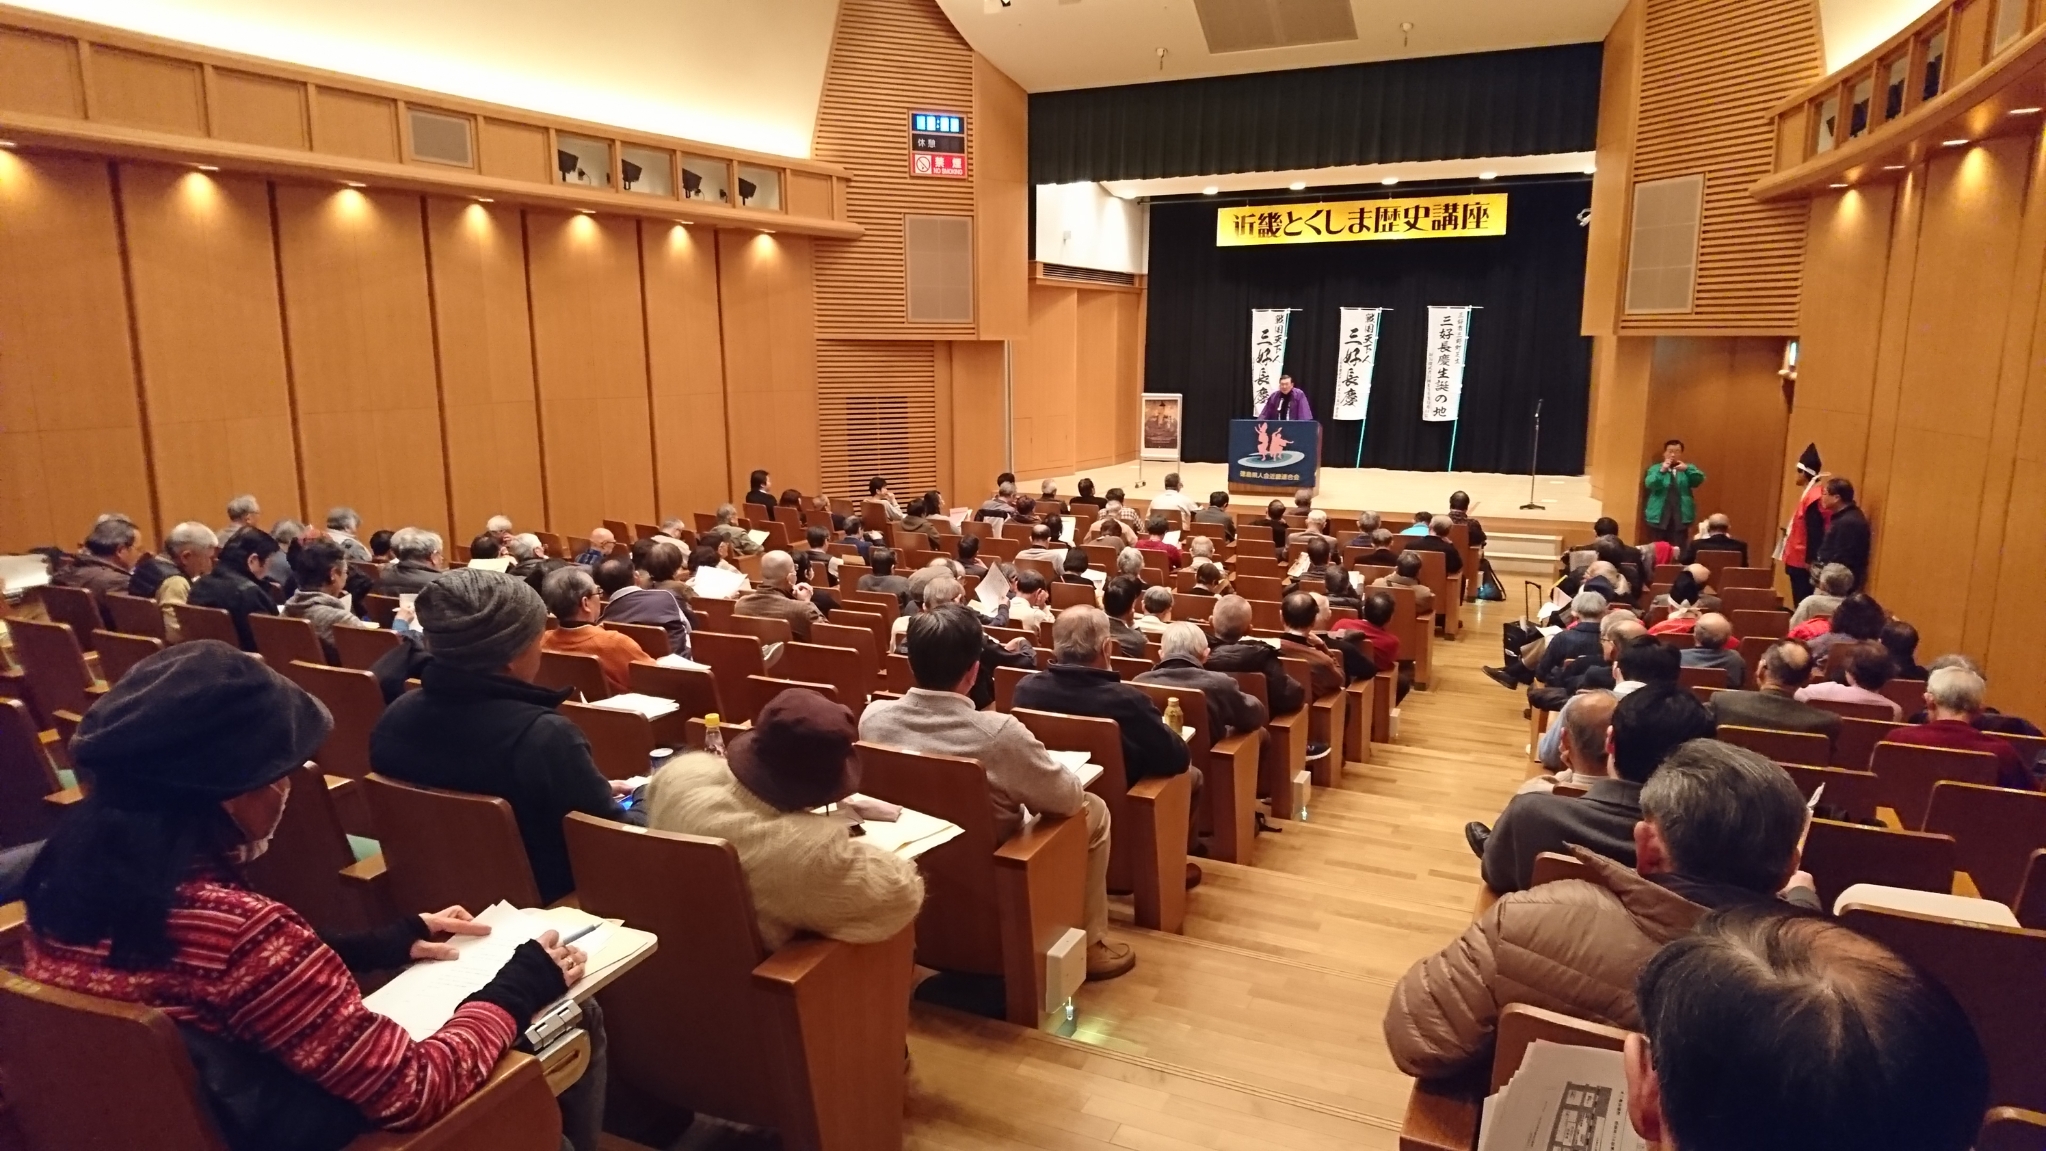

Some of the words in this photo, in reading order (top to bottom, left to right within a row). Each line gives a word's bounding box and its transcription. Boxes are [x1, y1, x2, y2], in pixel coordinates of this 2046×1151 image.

[1233, 202, 1490, 238] 近畿とくしま歴史講座
[1340, 327, 1363, 407] 三好長慶
[1433, 315, 1454, 417] 三好長慶生誕の地
